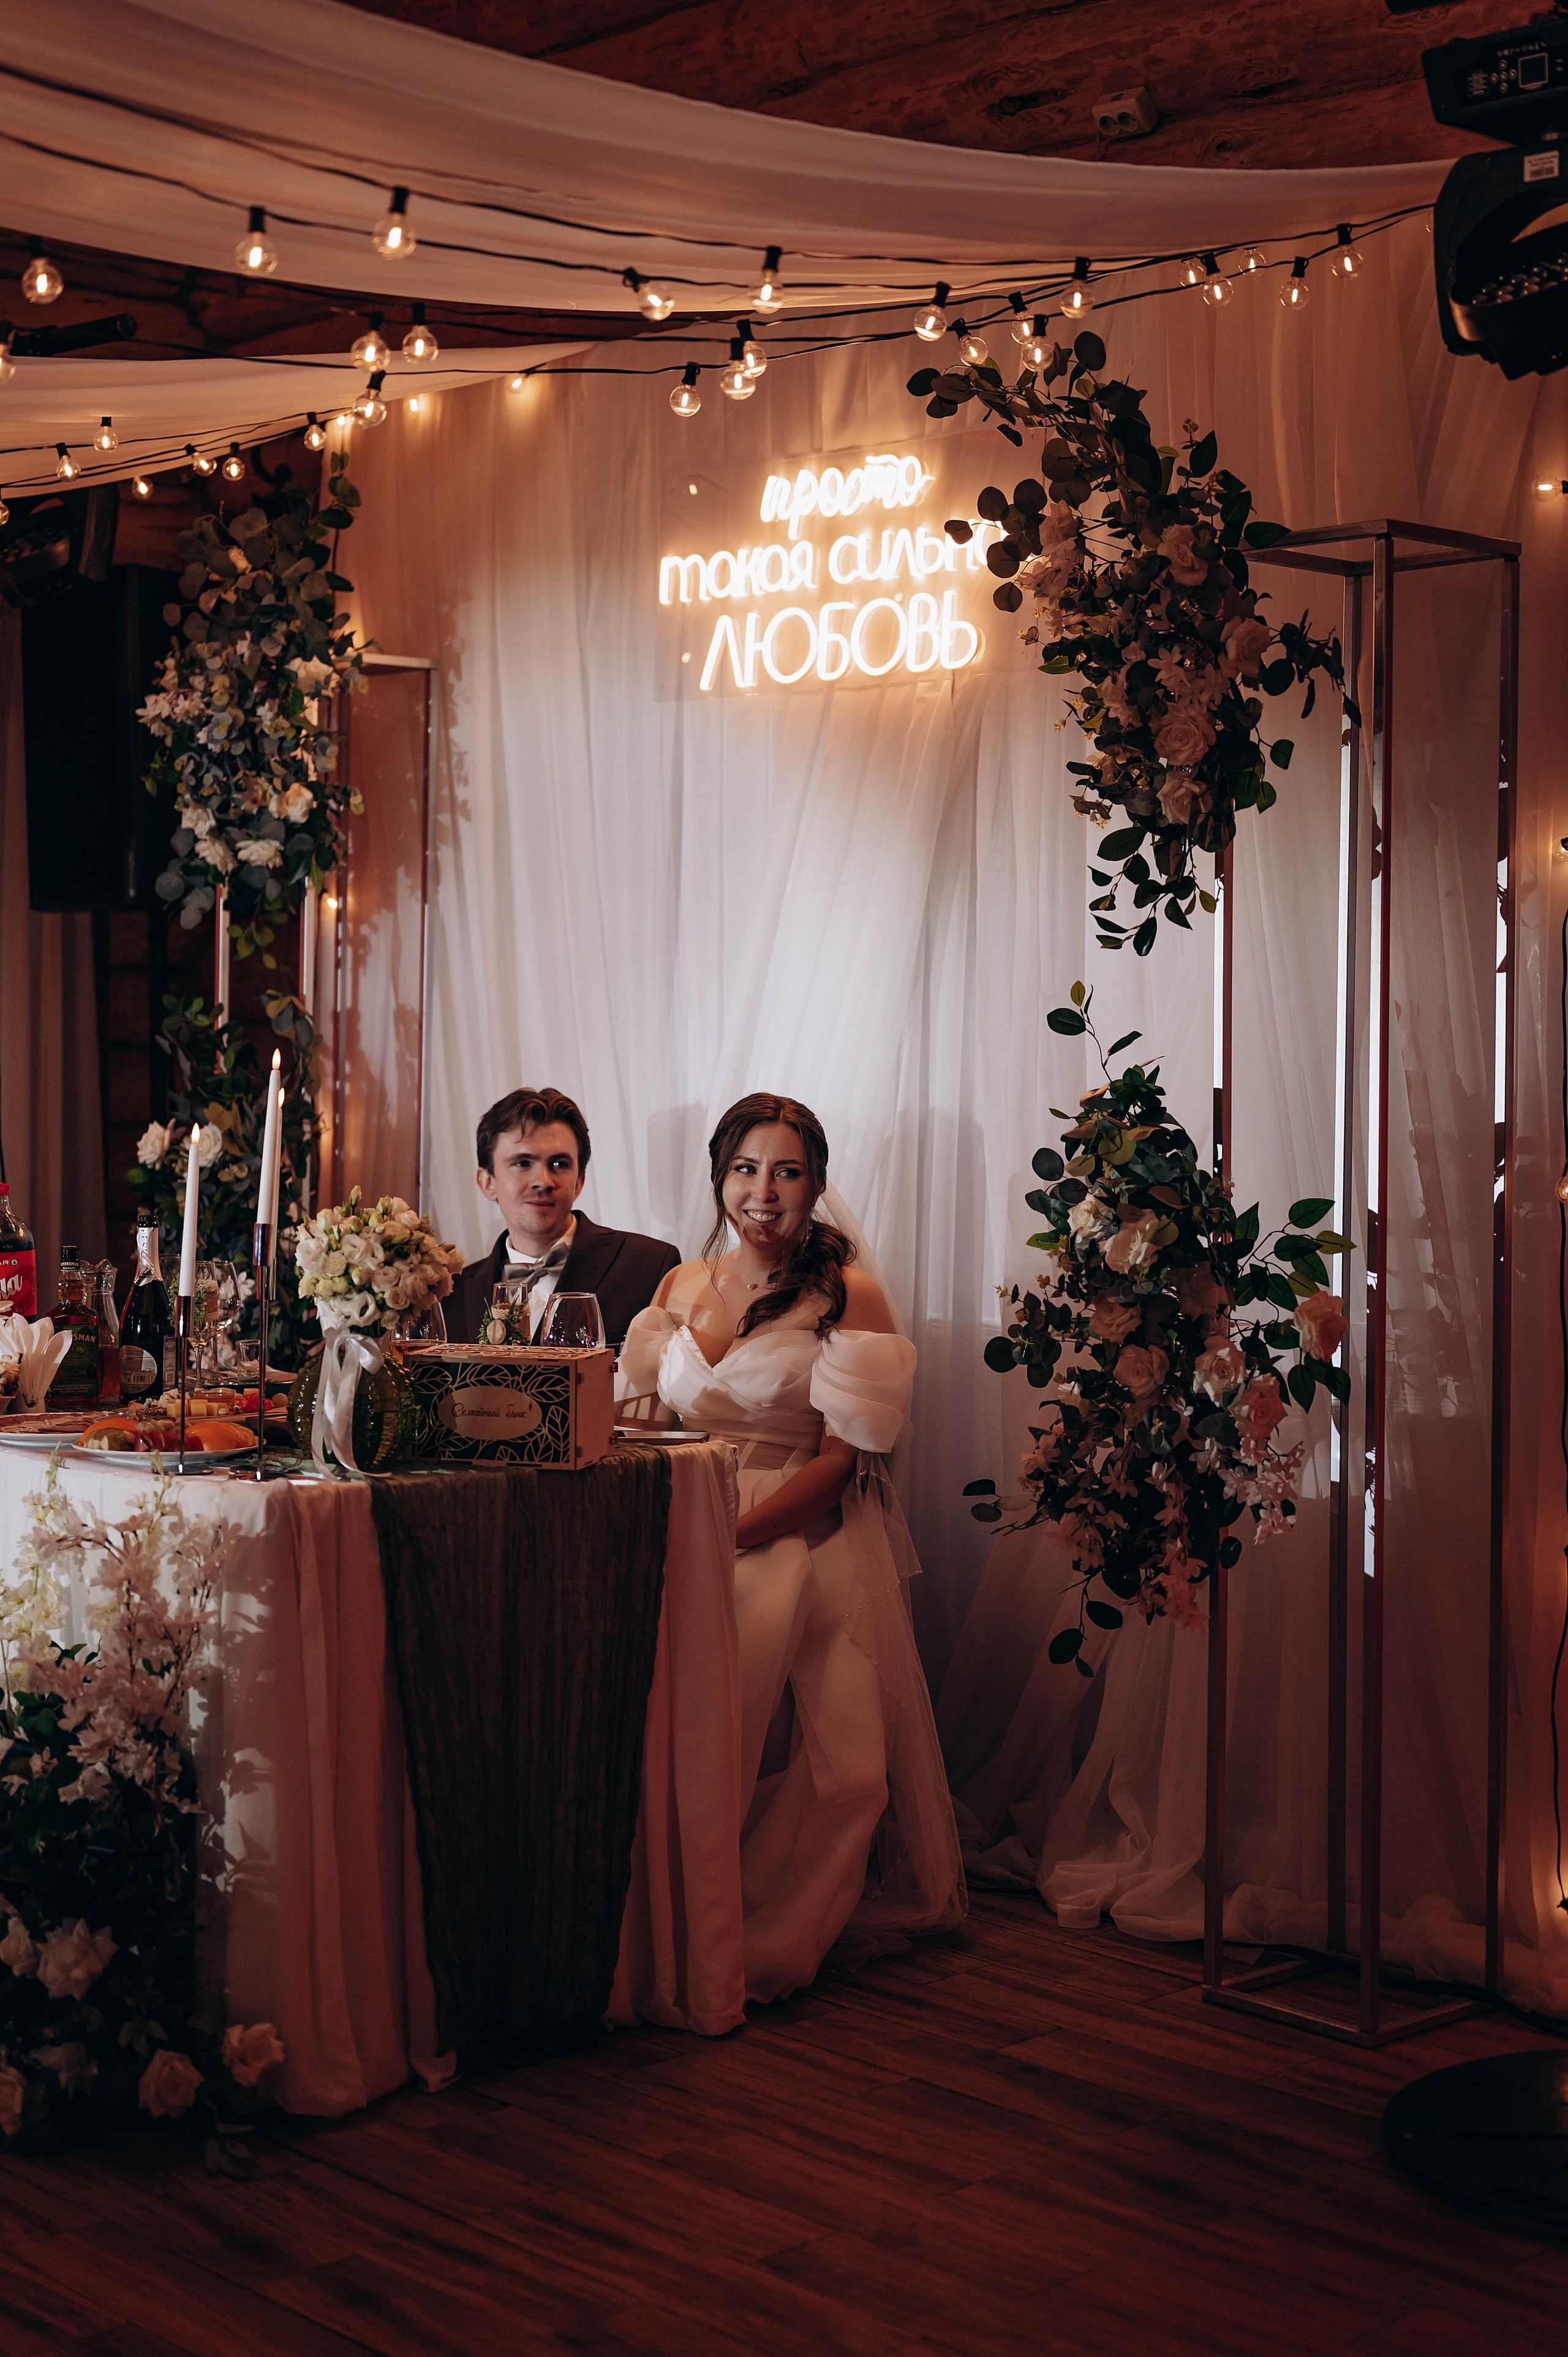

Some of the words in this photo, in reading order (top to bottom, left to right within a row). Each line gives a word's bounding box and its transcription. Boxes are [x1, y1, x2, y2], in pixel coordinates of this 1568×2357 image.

[760, 454, 936, 540] просто
[659, 540, 818, 605] такая
[699, 590, 983, 690] ЛЮБОВЬ
[451, 1403, 500, 1417] Семейный
[505, 1404, 527, 1418] банк
